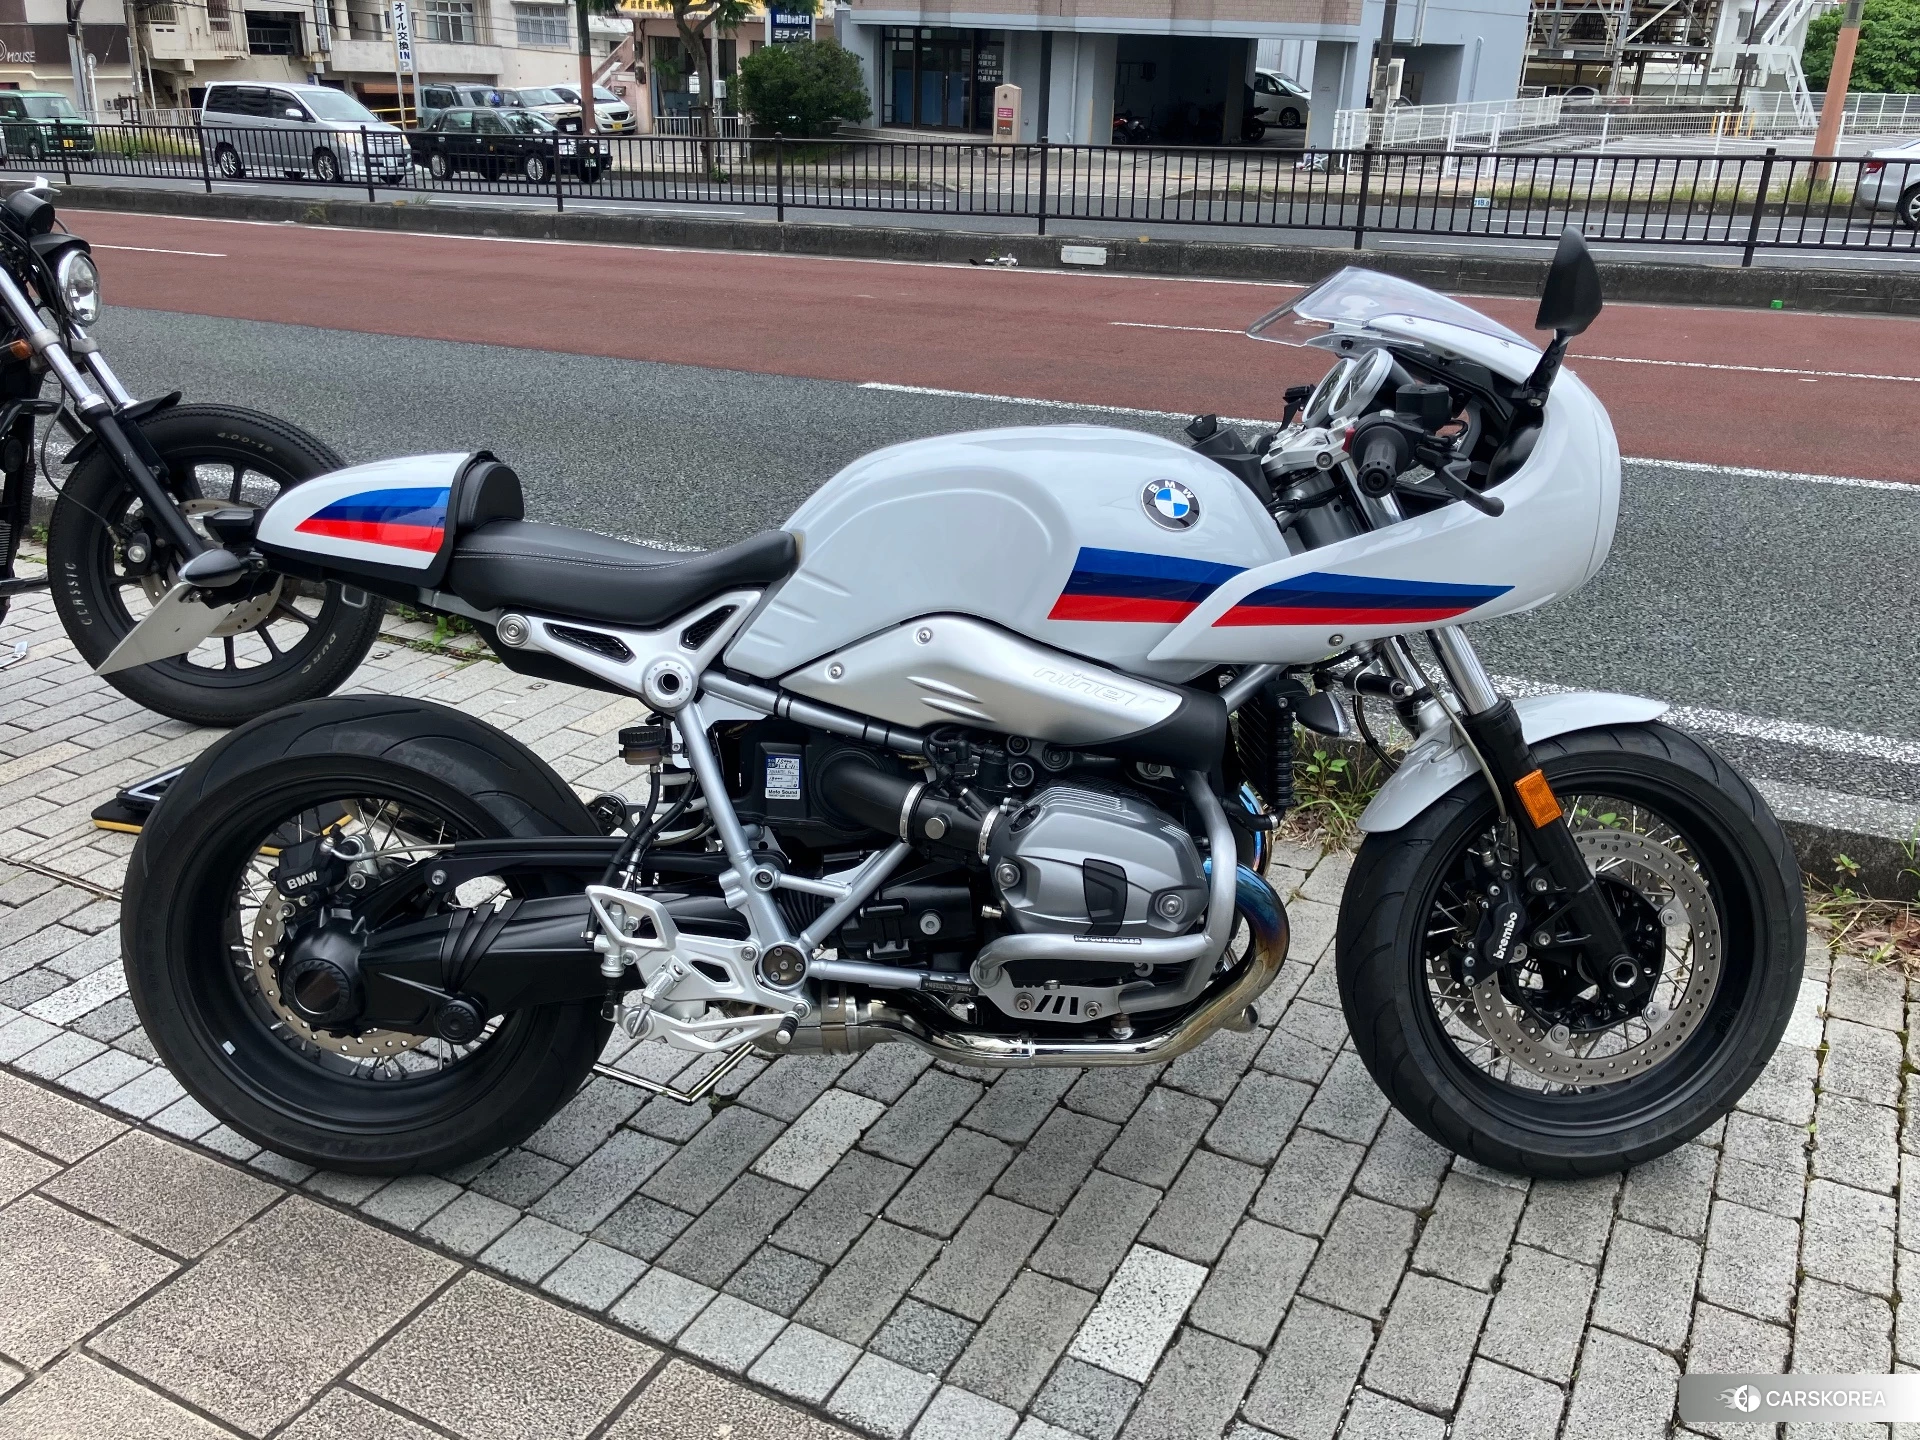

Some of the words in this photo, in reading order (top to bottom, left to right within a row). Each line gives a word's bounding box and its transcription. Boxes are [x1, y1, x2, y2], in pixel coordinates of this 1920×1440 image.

[1147, 480, 1194, 499] BMW
[64, 562, 93, 625] CLASSIC
[301, 632, 337, 674] DURO
[286, 870, 318, 890] BMW
[1492, 911, 1518, 960] brembo
